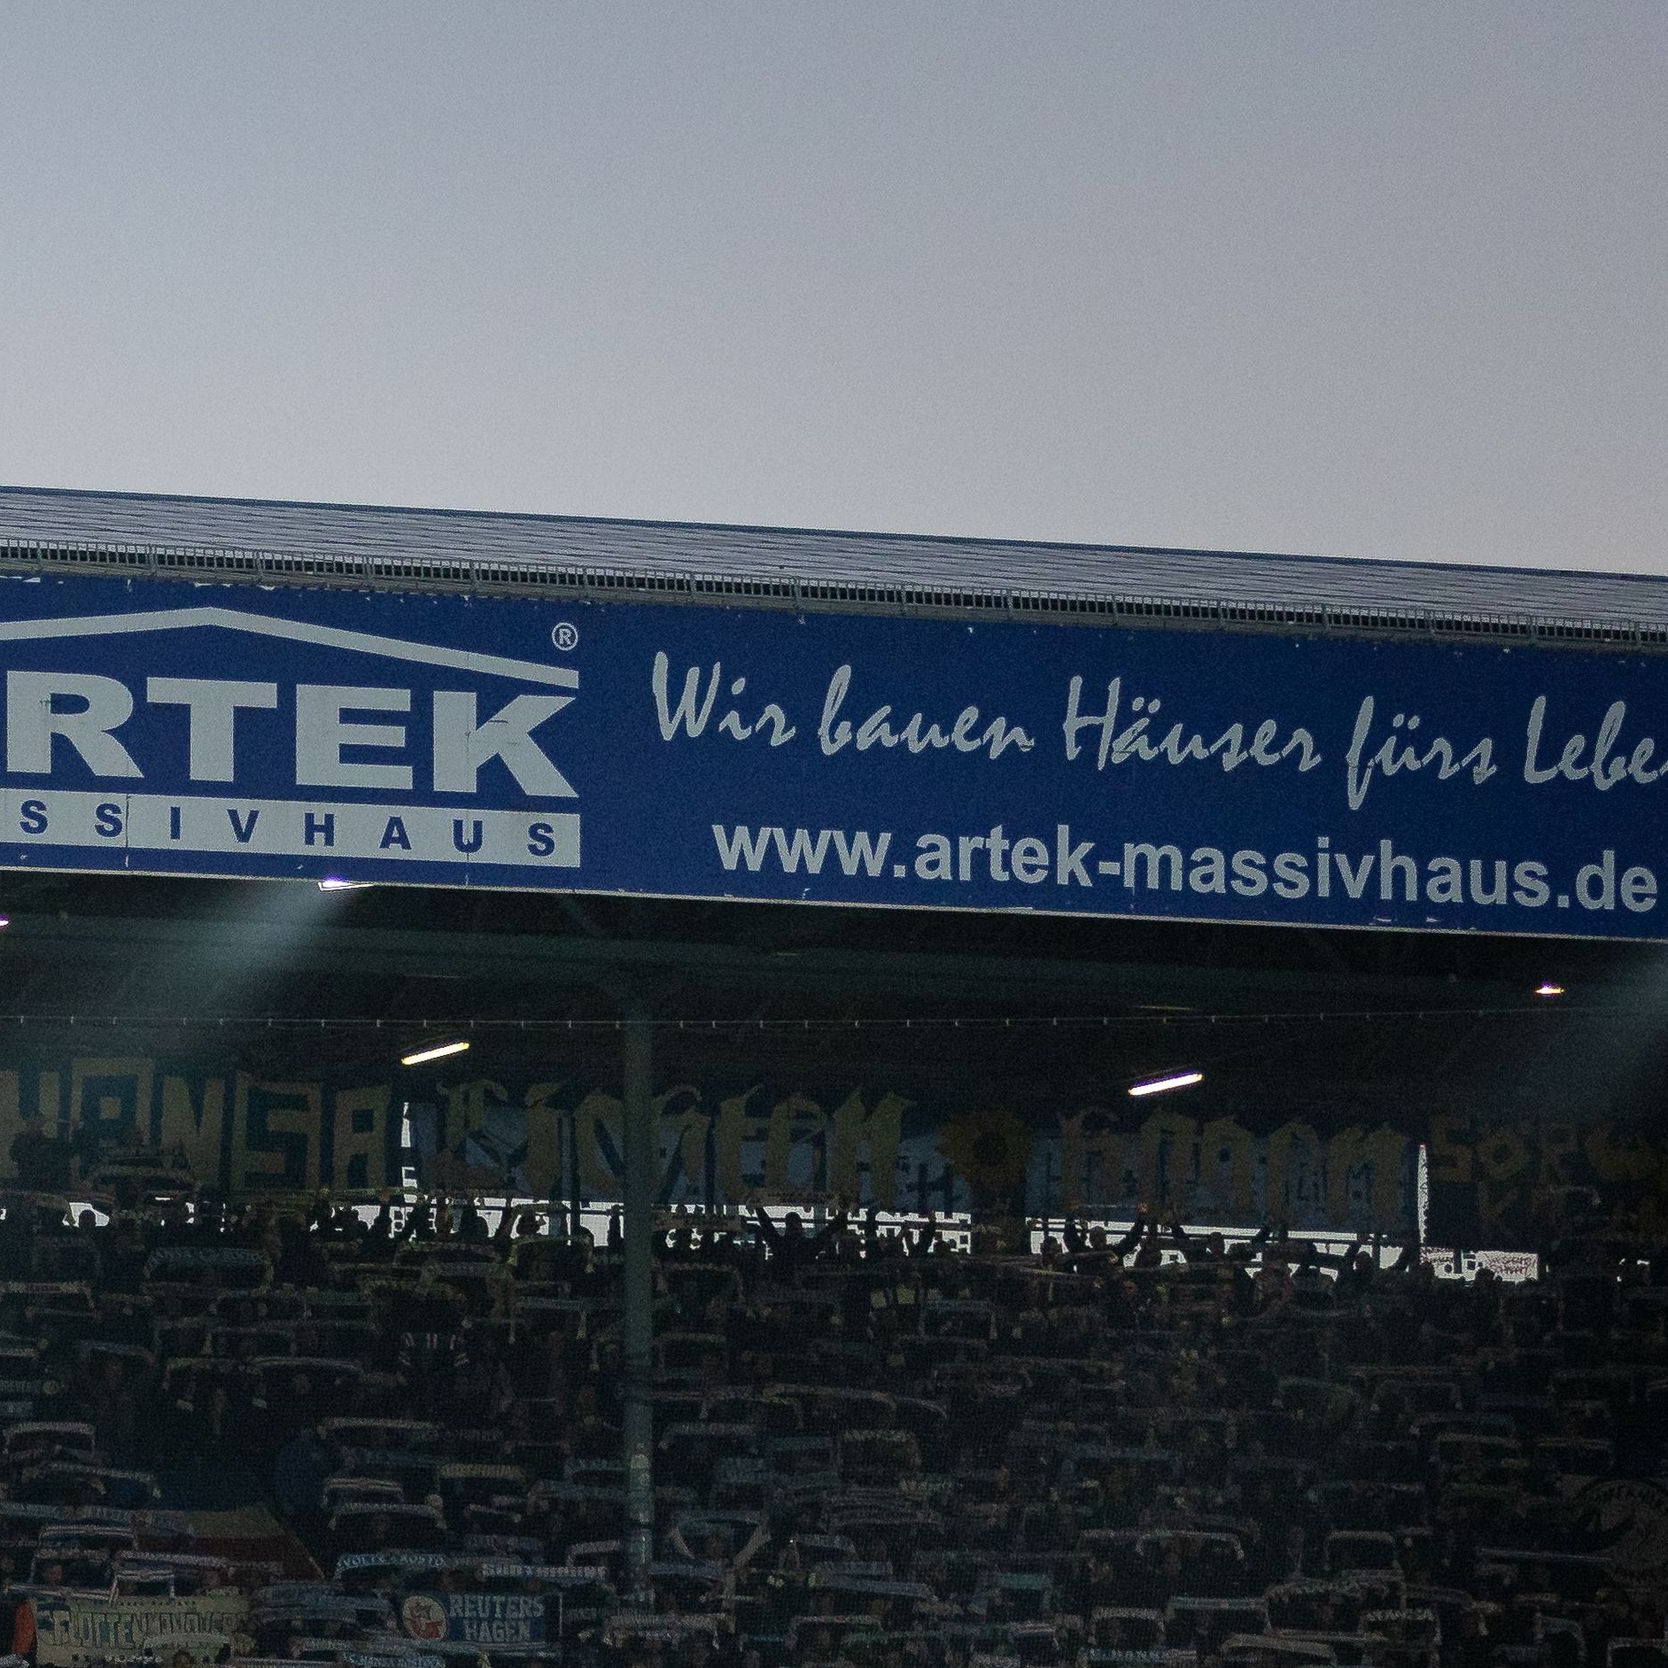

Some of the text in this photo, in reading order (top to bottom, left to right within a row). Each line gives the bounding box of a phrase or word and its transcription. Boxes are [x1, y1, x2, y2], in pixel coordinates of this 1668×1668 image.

[652, 651, 795, 746] Wir
[818, 665, 1035, 759] bauen
[1064, 676, 1322, 777] Häuser
[1346, 696, 1498, 810] fürs
[712, 822, 1658, 914] www.artek-massivhaus.de
[450, 1594, 545, 1618] REUTERS
[463, 1618, 532, 1642] HAGEN
